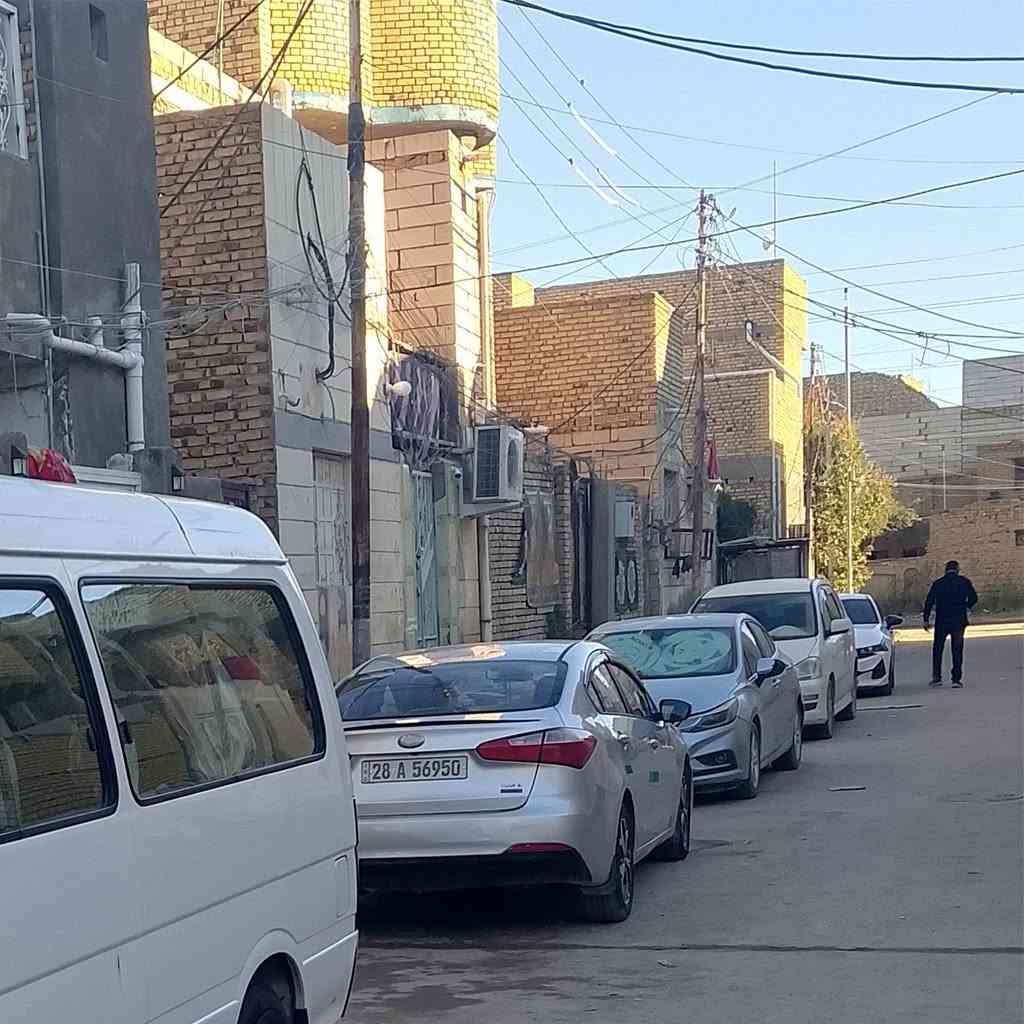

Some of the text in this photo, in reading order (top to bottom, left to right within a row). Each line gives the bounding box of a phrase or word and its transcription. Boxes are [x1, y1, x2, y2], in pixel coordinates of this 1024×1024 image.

[372, 762, 391, 780] 28
[396, 761, 406, 779] A
[412, 759, 461, 778] 56950
